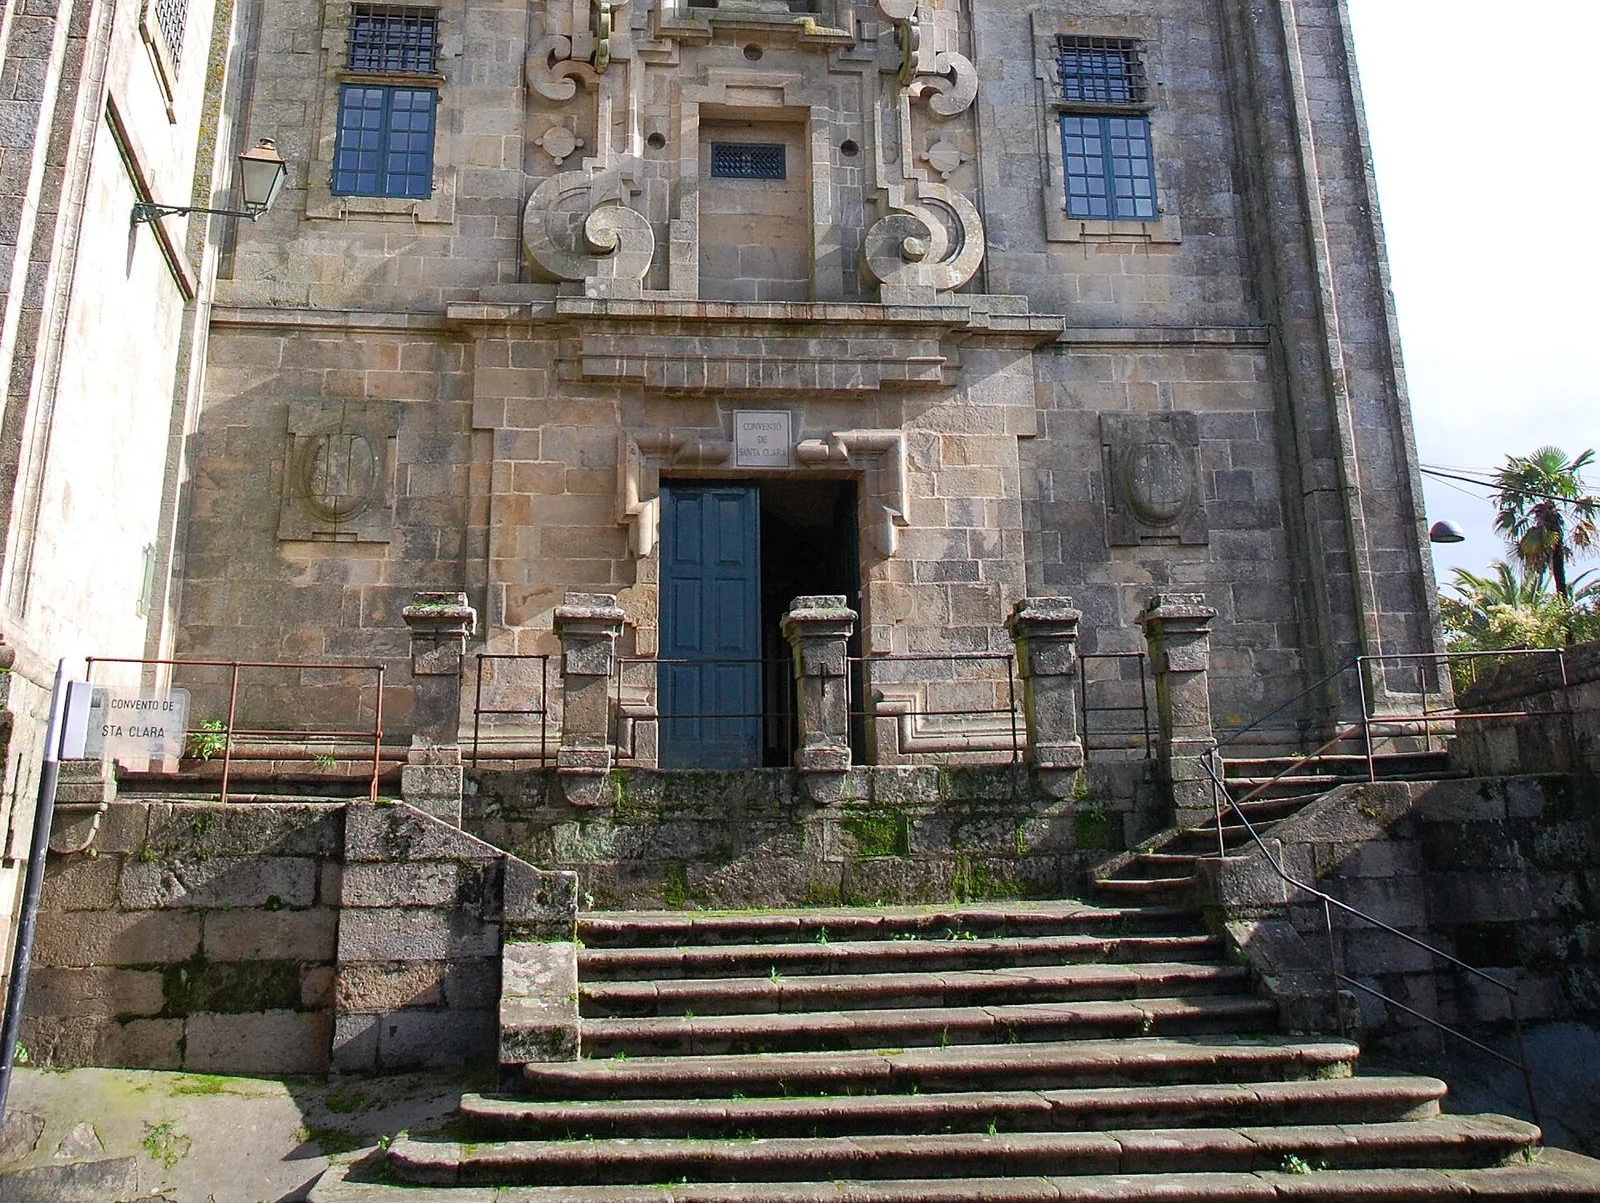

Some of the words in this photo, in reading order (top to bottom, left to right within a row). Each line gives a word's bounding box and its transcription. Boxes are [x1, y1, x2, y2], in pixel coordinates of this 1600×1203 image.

[742, 422, 782, 431] CONVENTO
[758, 436, 768, 444] DE
[738, 448, 760, 457] SANTA
[762, 448, 786, 457] CLARA
[111, 699, 158, 710] CONVENTO
[162, 701, 174, 711] DE
[102, 725, 122, 736] STA
[129, 726, 164, 738] CLARA
